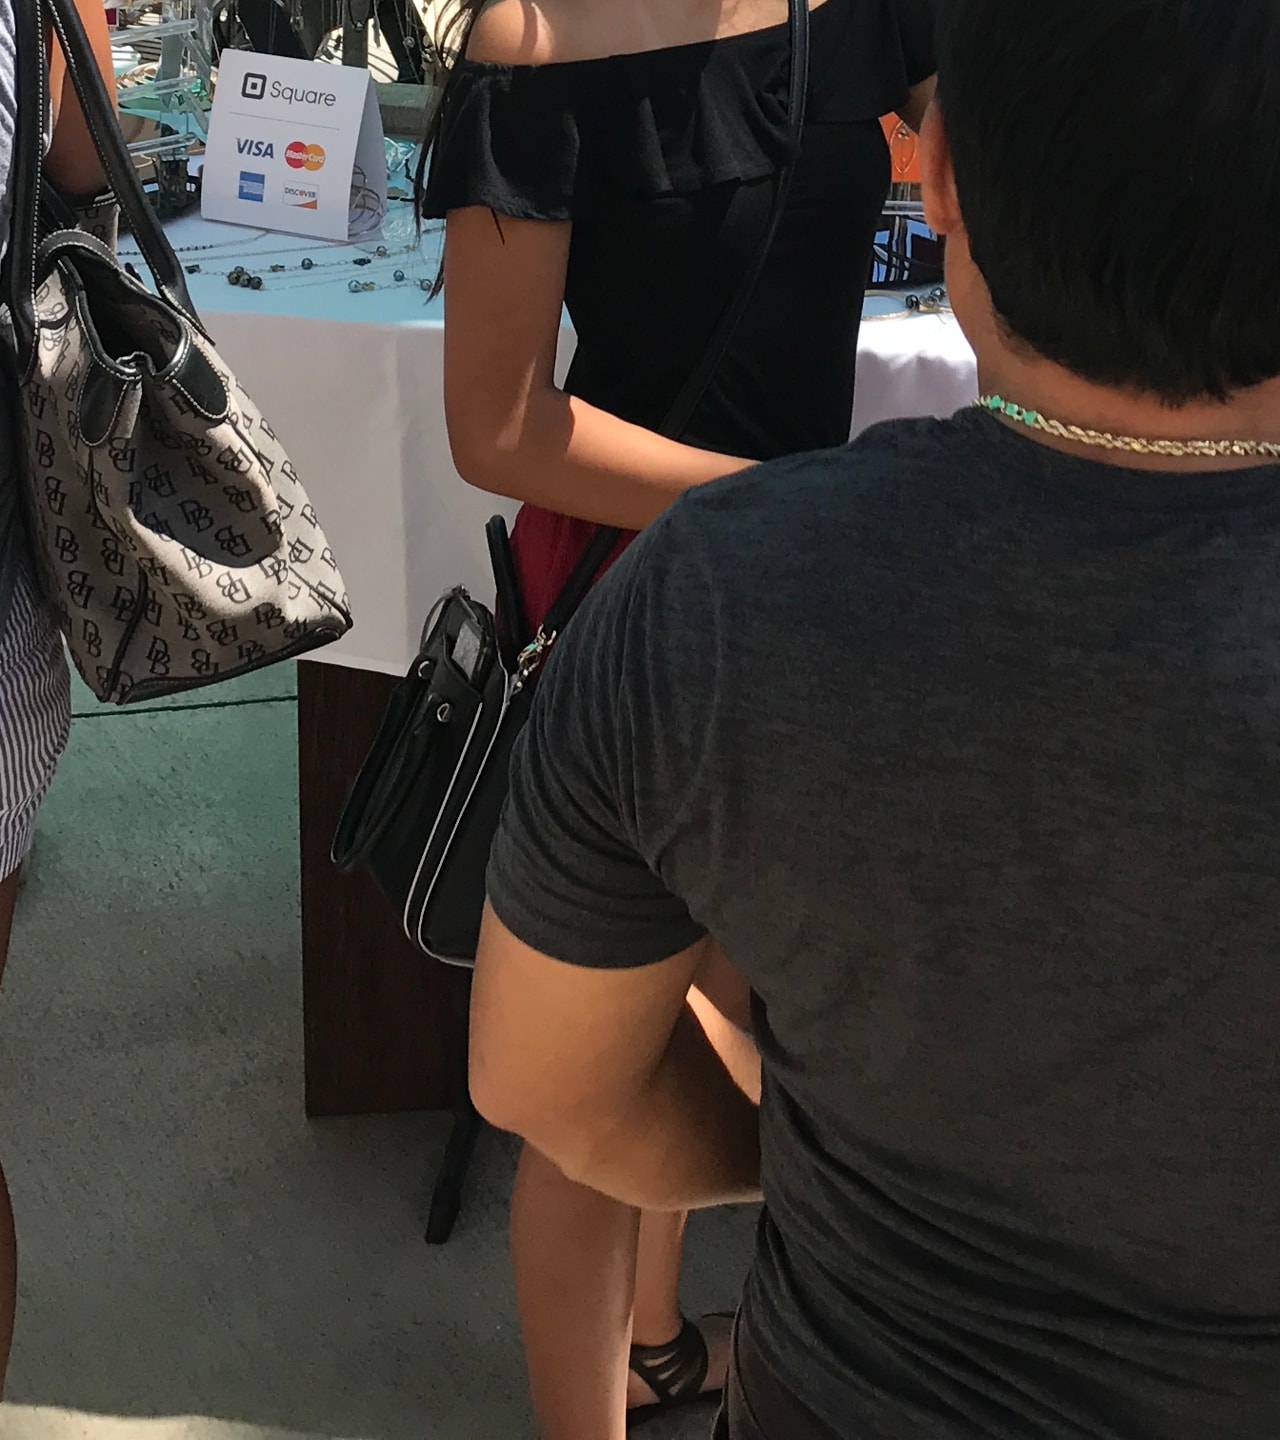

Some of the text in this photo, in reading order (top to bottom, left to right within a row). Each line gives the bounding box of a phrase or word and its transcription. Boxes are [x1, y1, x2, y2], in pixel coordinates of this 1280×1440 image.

[270, 80, 337, 107] Square
[235, 137, 274, 159] VISA
[284, 187, 317, 199] DISCOVER
